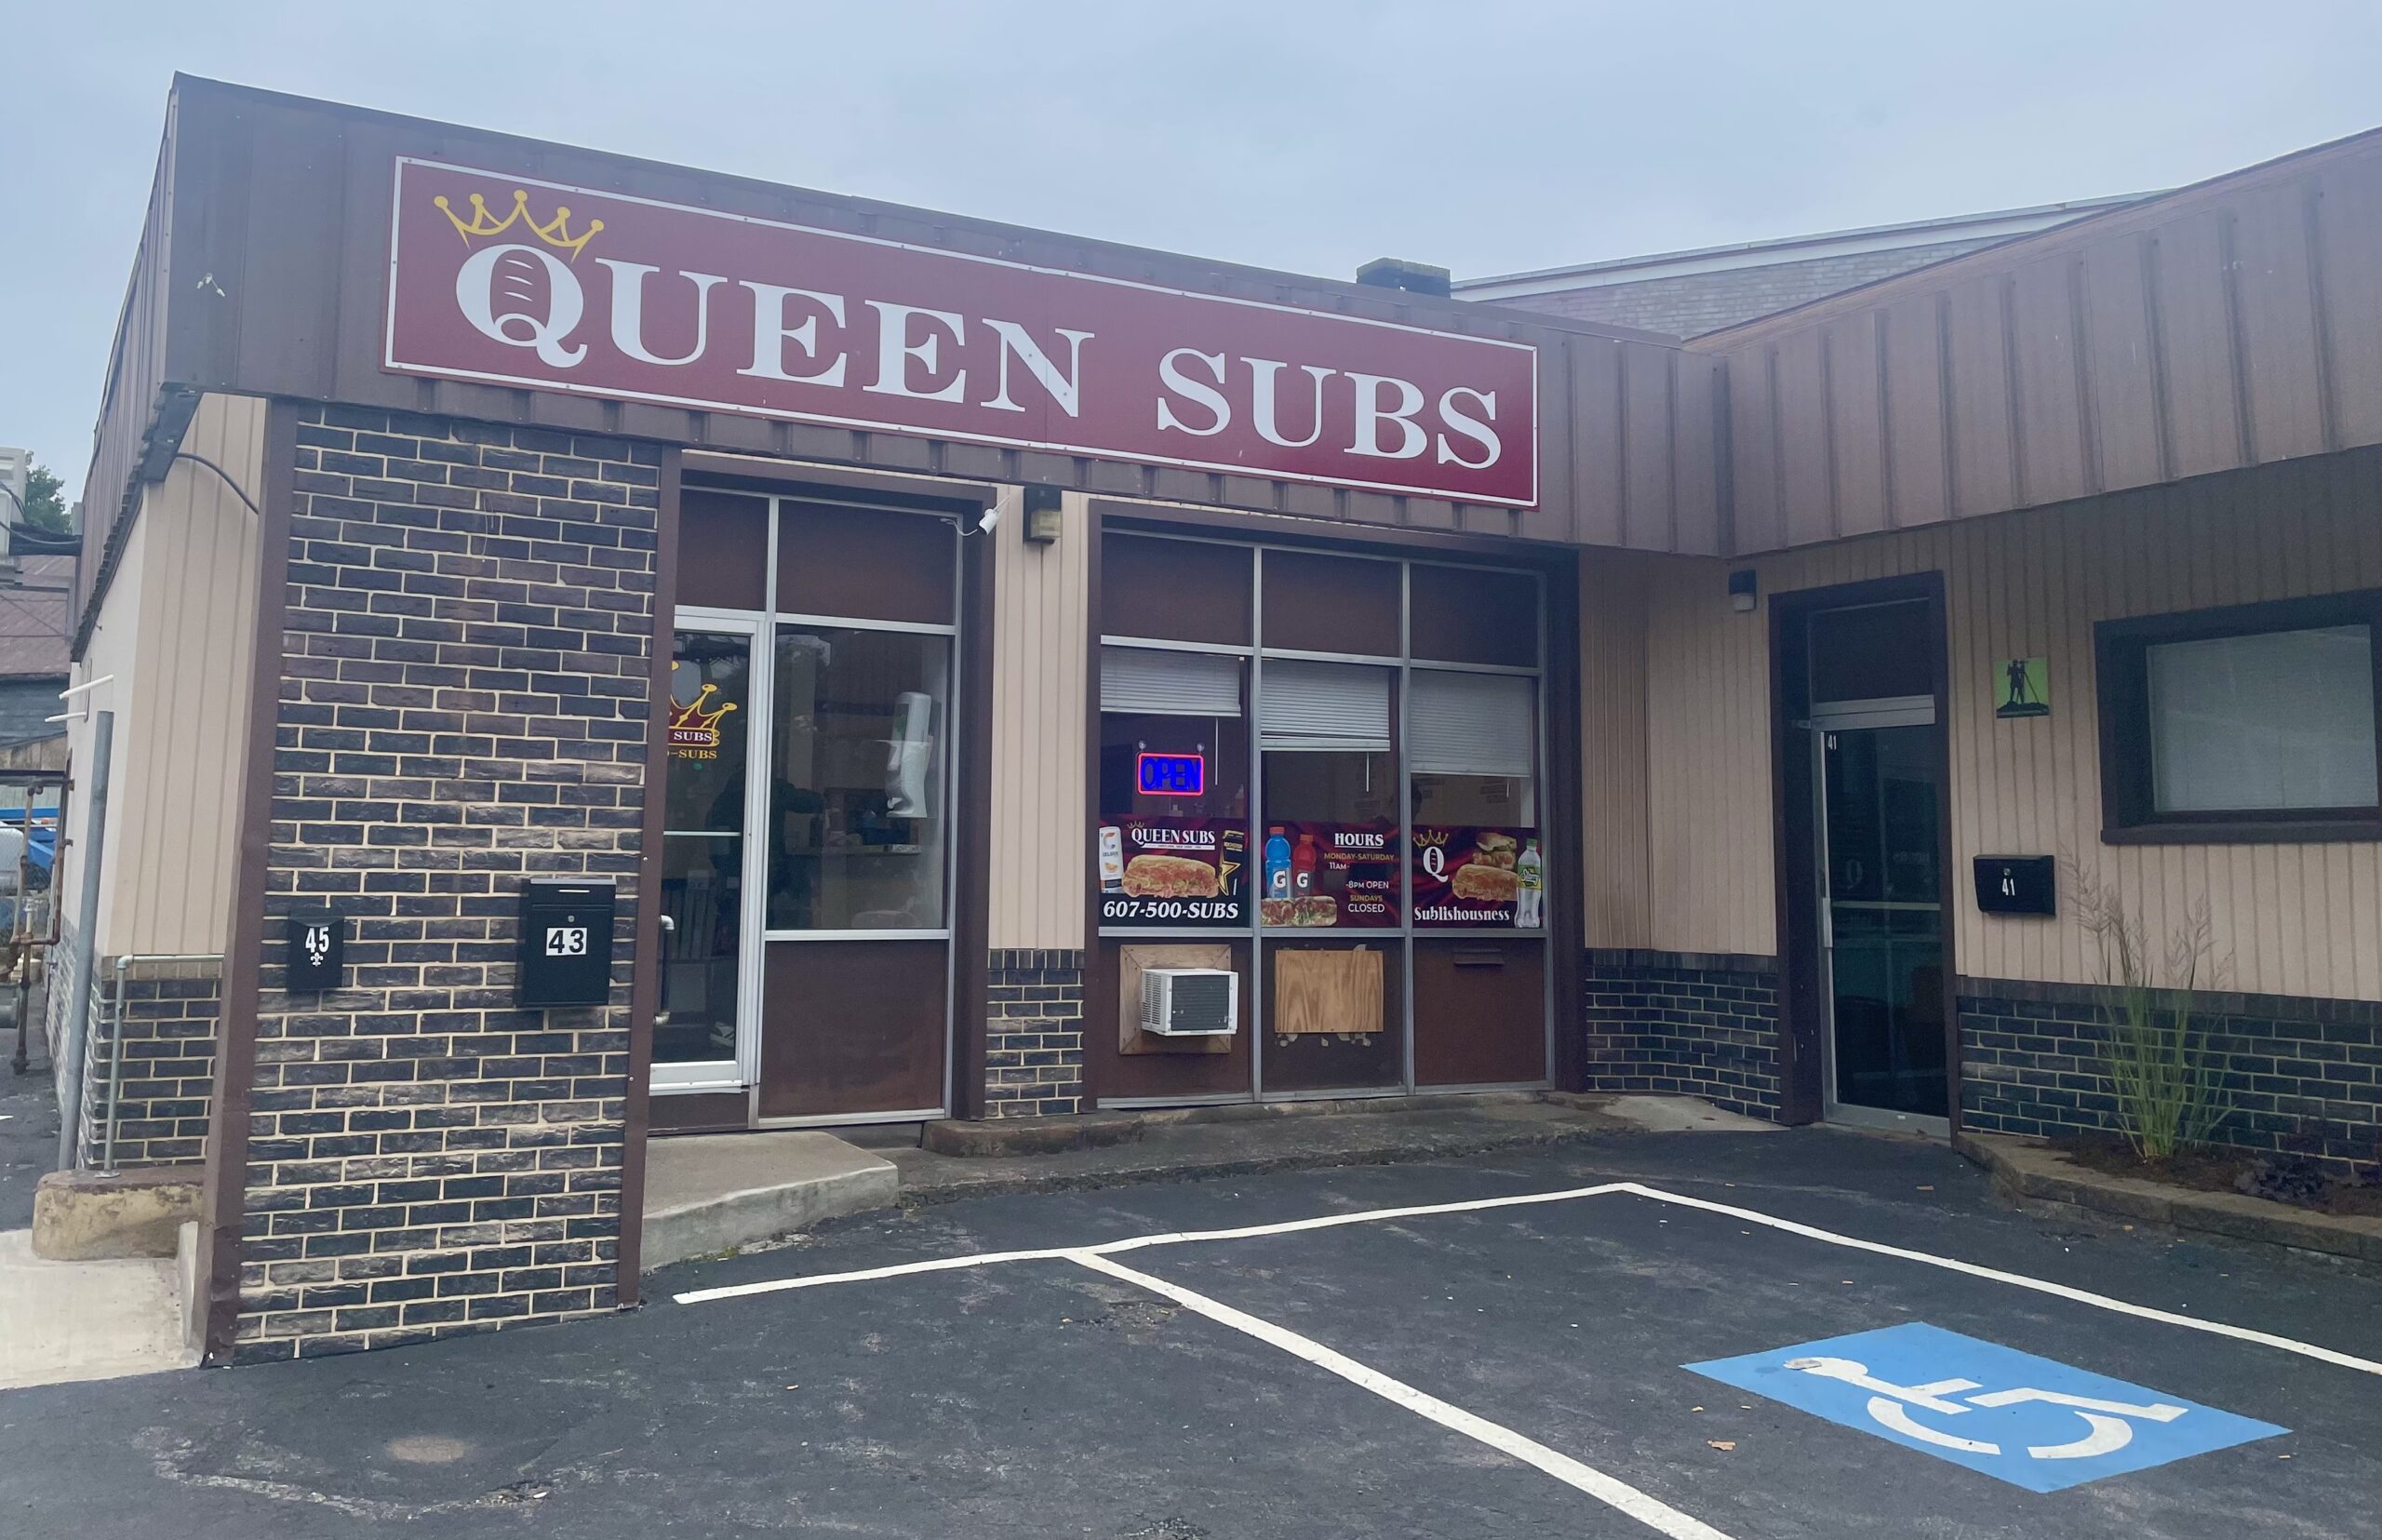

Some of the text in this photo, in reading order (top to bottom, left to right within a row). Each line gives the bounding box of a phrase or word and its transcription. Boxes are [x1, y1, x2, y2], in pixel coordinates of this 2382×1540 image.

[456, 243, 1501, 469] QUEEN SUBS
[674, 731, 713, 742] SUBS
[1828, 734, 1837, 750] 41
[1141, 757, 1201, 790] OPEN
[1131, 827, 1216, 845] QUEEN SUBS
[1334, 833, 1385, 847] HOURS
[1324, 852, 1395, 861] MONDAY-SATURDAY
[1423, 846, 1449, 883] Q
[1273, 871, 1287, 888] G
[1296, 872, 1309, 888] G
[1366, 881, 1389, 890] OPEN
[2002, 877, 2015, 896] 41
[1103, 901, 1238, 918] 607-500-SUBS
[1347, 904, 1385, 913] CLOSED
[1414, 906, 1510, 920] Sublishousness
[305, 926, 330, 954] 45
[548, 930, 585, 955] 43
